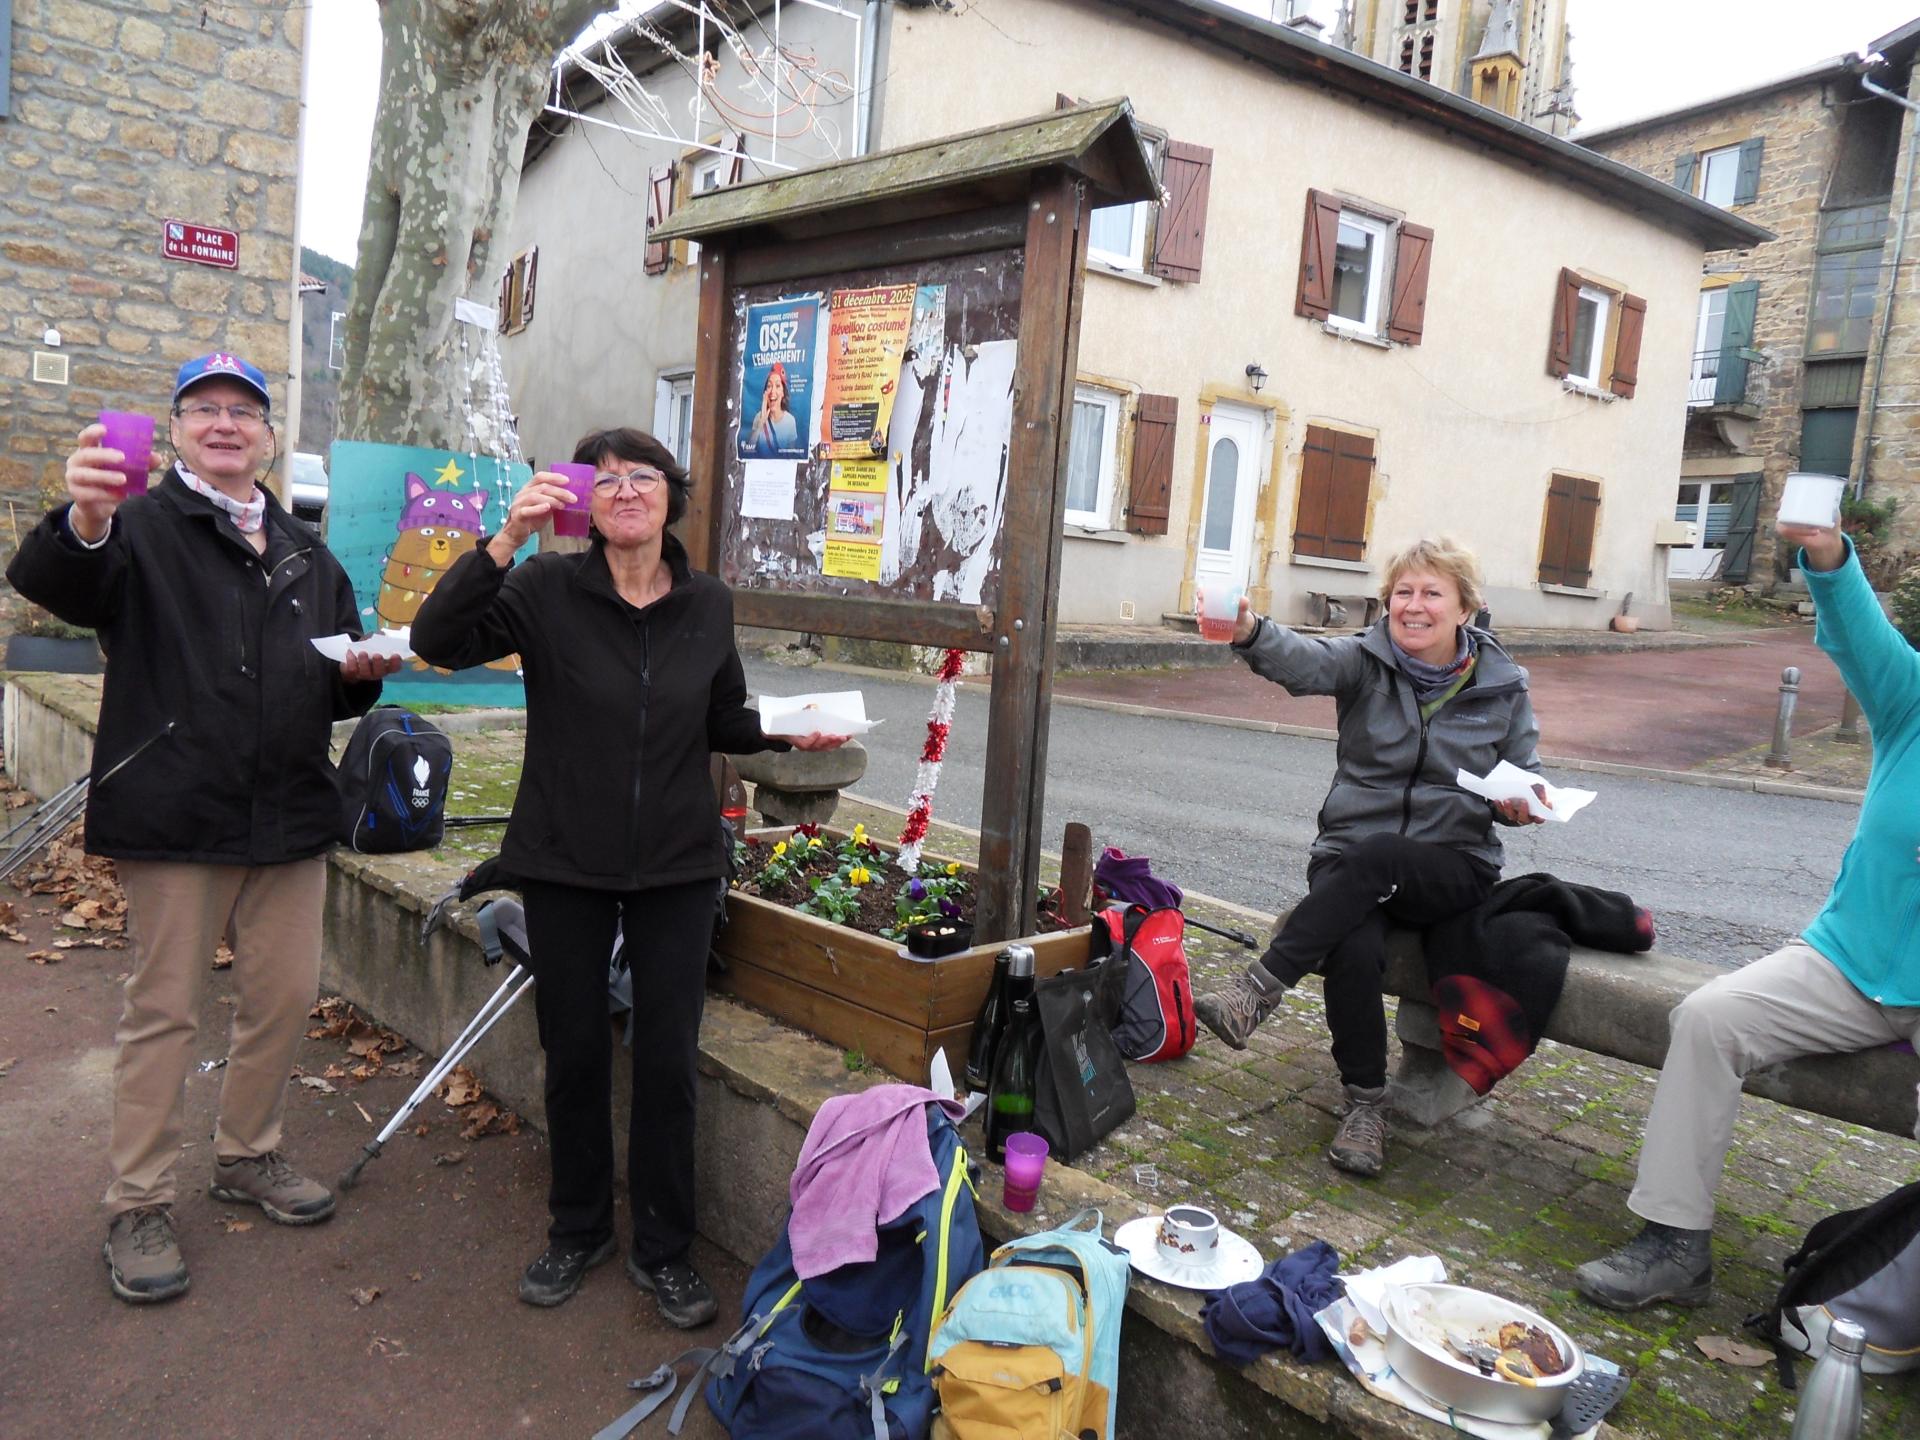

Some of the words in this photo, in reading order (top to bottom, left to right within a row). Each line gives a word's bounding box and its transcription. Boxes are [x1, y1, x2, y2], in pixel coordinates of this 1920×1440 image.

[195, 231, 223, 247] PLACE
[168, 241, 178, 252] de
[180, 242, 189, 254] la
[191, 244, 234, 262] FONTAINE
[832, 294, 841, 309] 31
[843, 291, 887, 308] décembre
[889, 288, 914, 304] 2025
[759, 320, 799, 353] OSEZ
[830, 321, 866, 337] Réveillon
[867, 317, 906, 333] costumé
[412, 787, 430, 798] FRANCE
